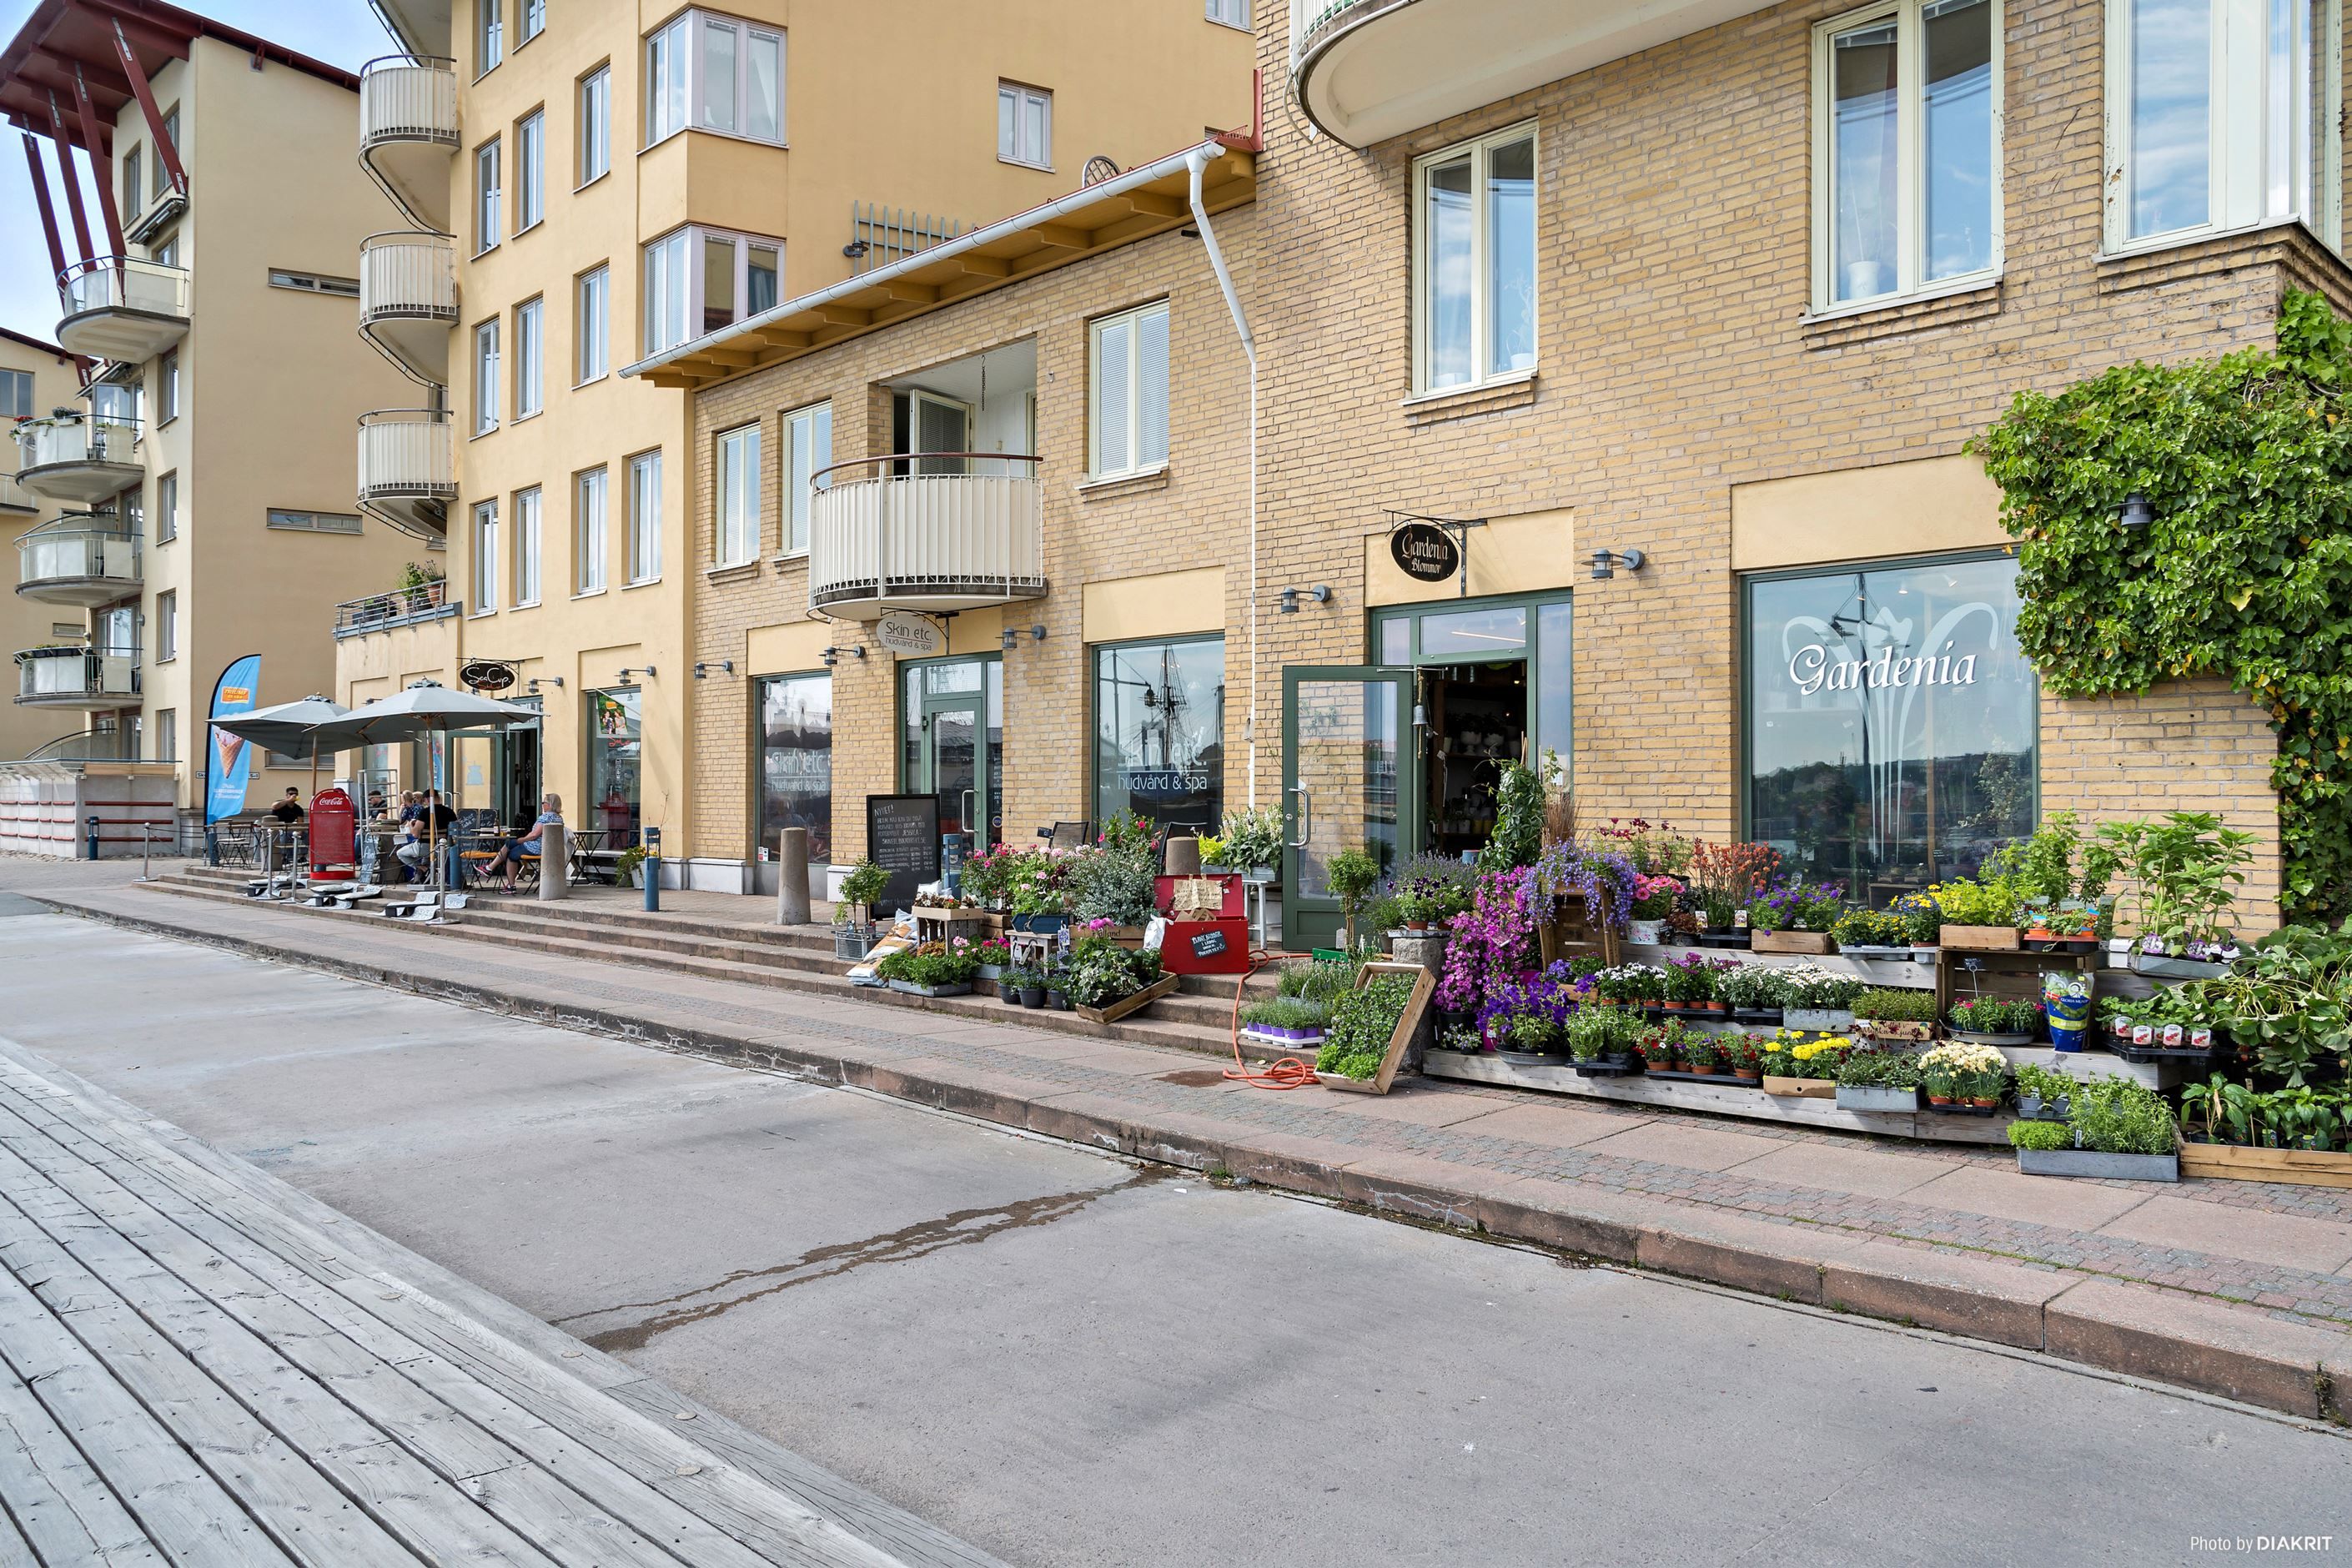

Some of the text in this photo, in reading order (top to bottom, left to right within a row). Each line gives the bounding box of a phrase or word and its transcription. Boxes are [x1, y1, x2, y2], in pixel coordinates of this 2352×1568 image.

[1402, 532, 1449, 560] Gardenia
[1411, 557, 1441, 574] Blommor
[886, 621, 932, 641] Skin etc.
[886, 636, 913, 648] hudvård
[921, 643, 932, 651] spa
[1789, 640, 1978, 696] Gardenia
[812, 781, 827, 794] spa
[1118, 774, 1208, 794] hudvård & spa
